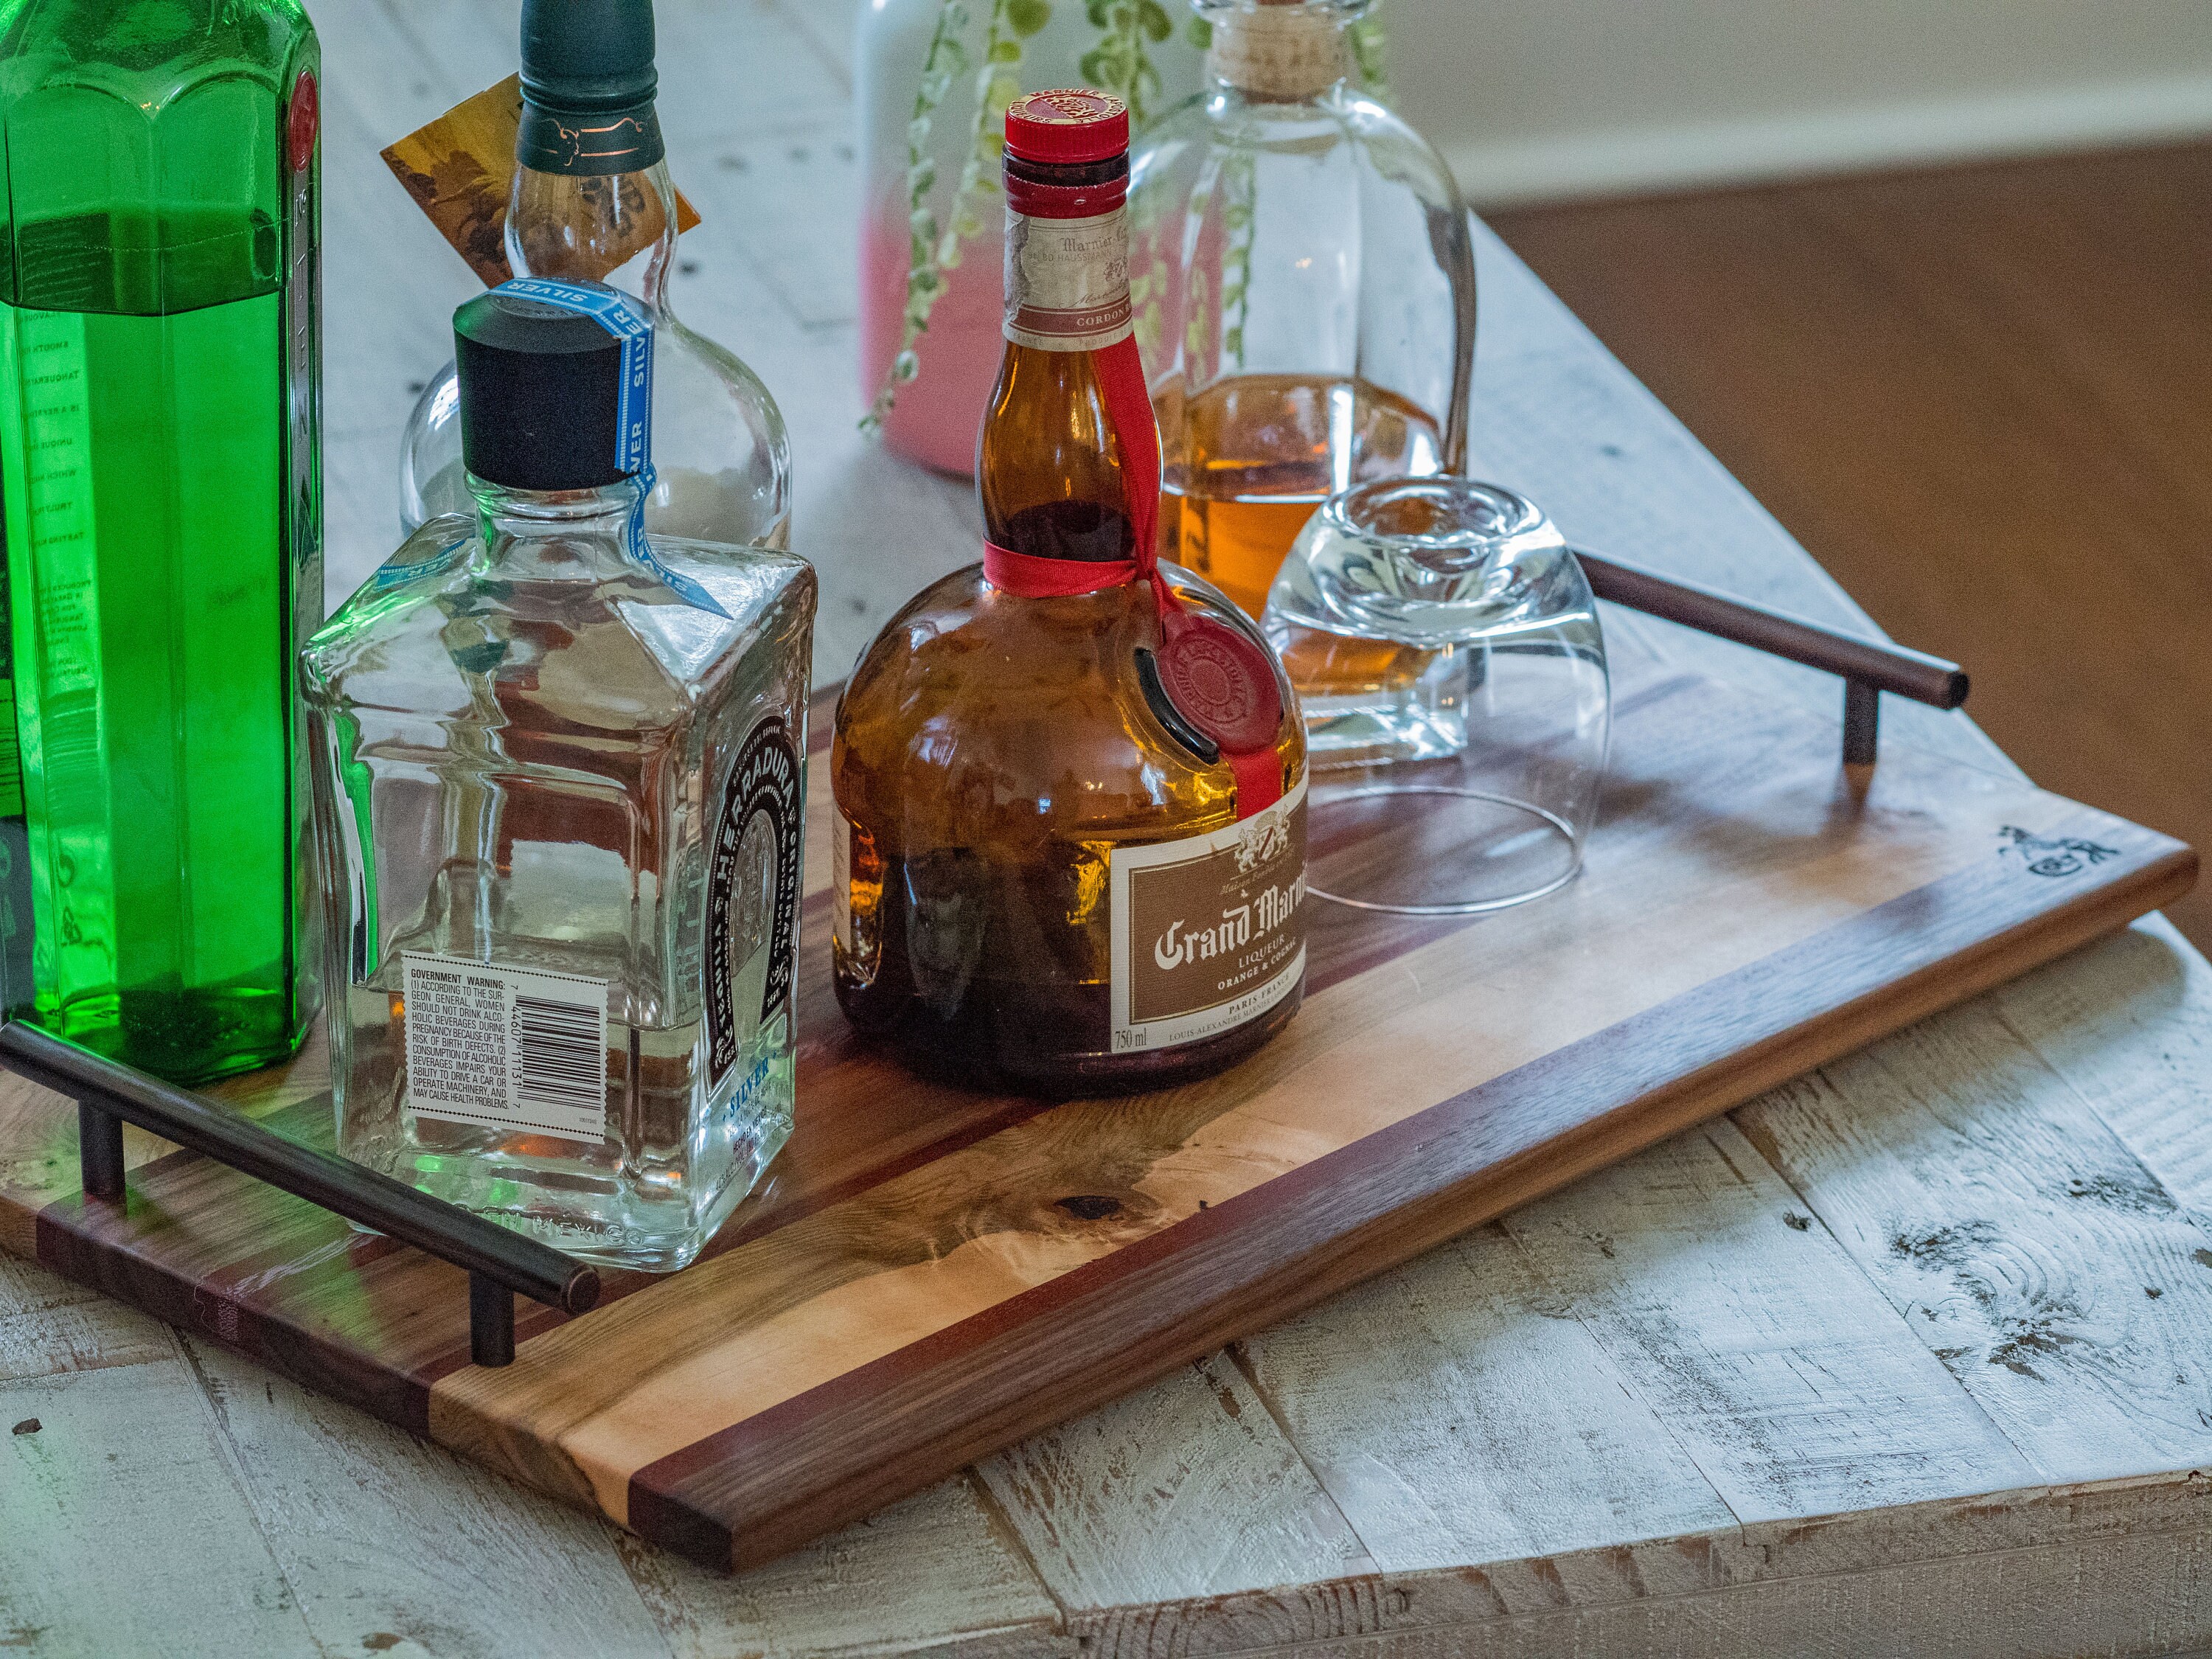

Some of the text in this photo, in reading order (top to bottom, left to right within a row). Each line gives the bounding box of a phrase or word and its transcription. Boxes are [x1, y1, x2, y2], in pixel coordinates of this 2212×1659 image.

[1010, 100, 1052, 124] LIQUEURS
[1029, 88, 1123, 124] MARNIER LAPOSTOLLE
[507, 282, 588, 302] SILVER
[1077, 309, 1124, 327] CORDON
[717, 746, 794, 880] HERRADURA
[780, 831, 796, 950] ORIGINAL
[1155, 905, 1250, 970] Grand
[1239, 933, 1284, 968] LIQUEUR
[1217, 936, 1297, 990] ORANGE & COGNAC
[411, 968, 505, 990] GOVERNMENT WARNING:
[714, 923, 727, 1028] TEQUILA
[411, 990, 504, 1012] GEON GENERAL, WOMEN
[421, 981, 461, 995] ACCORDING
[462, 987, 471, 996] TO
[473, 988, 487, 998] THE
[488, 990, 504, 1000] SUR-
[411, 1001, 504, 1022] SHOULD NOT DRINK ALCO-
[412, 1012, 505, 1033] HOLIC BEVERAGES DURING
[412, 1023, 506, 1044] PREGNANCY BECAUSE OF THE
[511, 1006, 522, 1044] 44607
[412, 1034, 506, 1056] RISK OF BIRTH DEFECTS. (2)
[1115, 1028, 1147, 1049] 750 ml
[412, 1044, 506, 1066] CONSUMPTION OF ALCOHOLIC
[413, 1055, 506, 1077] BEVERAGES IMPAIRS YOUR
[413, 1066, 507, 1088] ABILITY TO DRIVE A CAR OR
[512, 1051, 522, 1087] 11131
[413, 1077, 507, 1098] OPERATE MACHINERY, AND
[730, 1056, 769, 1118] SILVER
[413, 1088, 509, 1110] MAY CAUSE HEALTH PROBLEMS.
[532, 1215, 644, 1248] MEXICO
